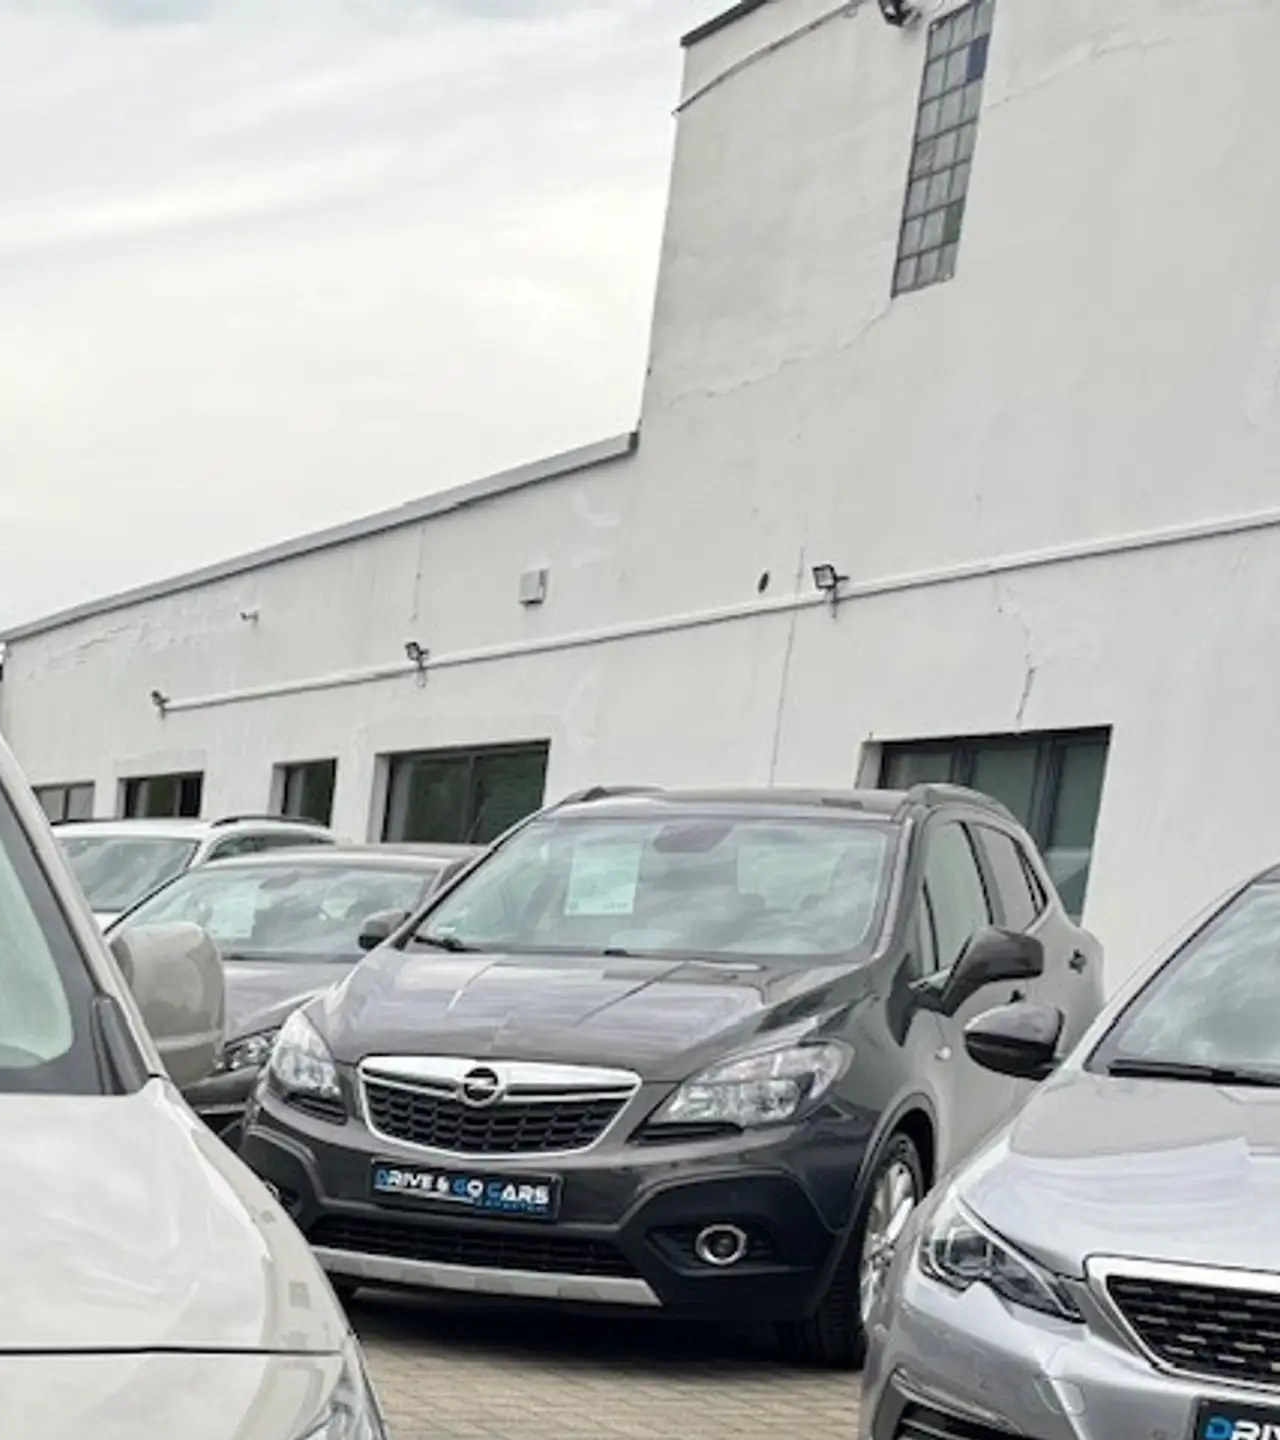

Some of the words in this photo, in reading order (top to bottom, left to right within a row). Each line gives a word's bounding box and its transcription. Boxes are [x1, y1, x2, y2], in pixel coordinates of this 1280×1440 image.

[375, 1169, 434, 1190] DRIVE
[452, 1178, 484, 1198] GO
[487, 1181, 549, 1204] CARS
